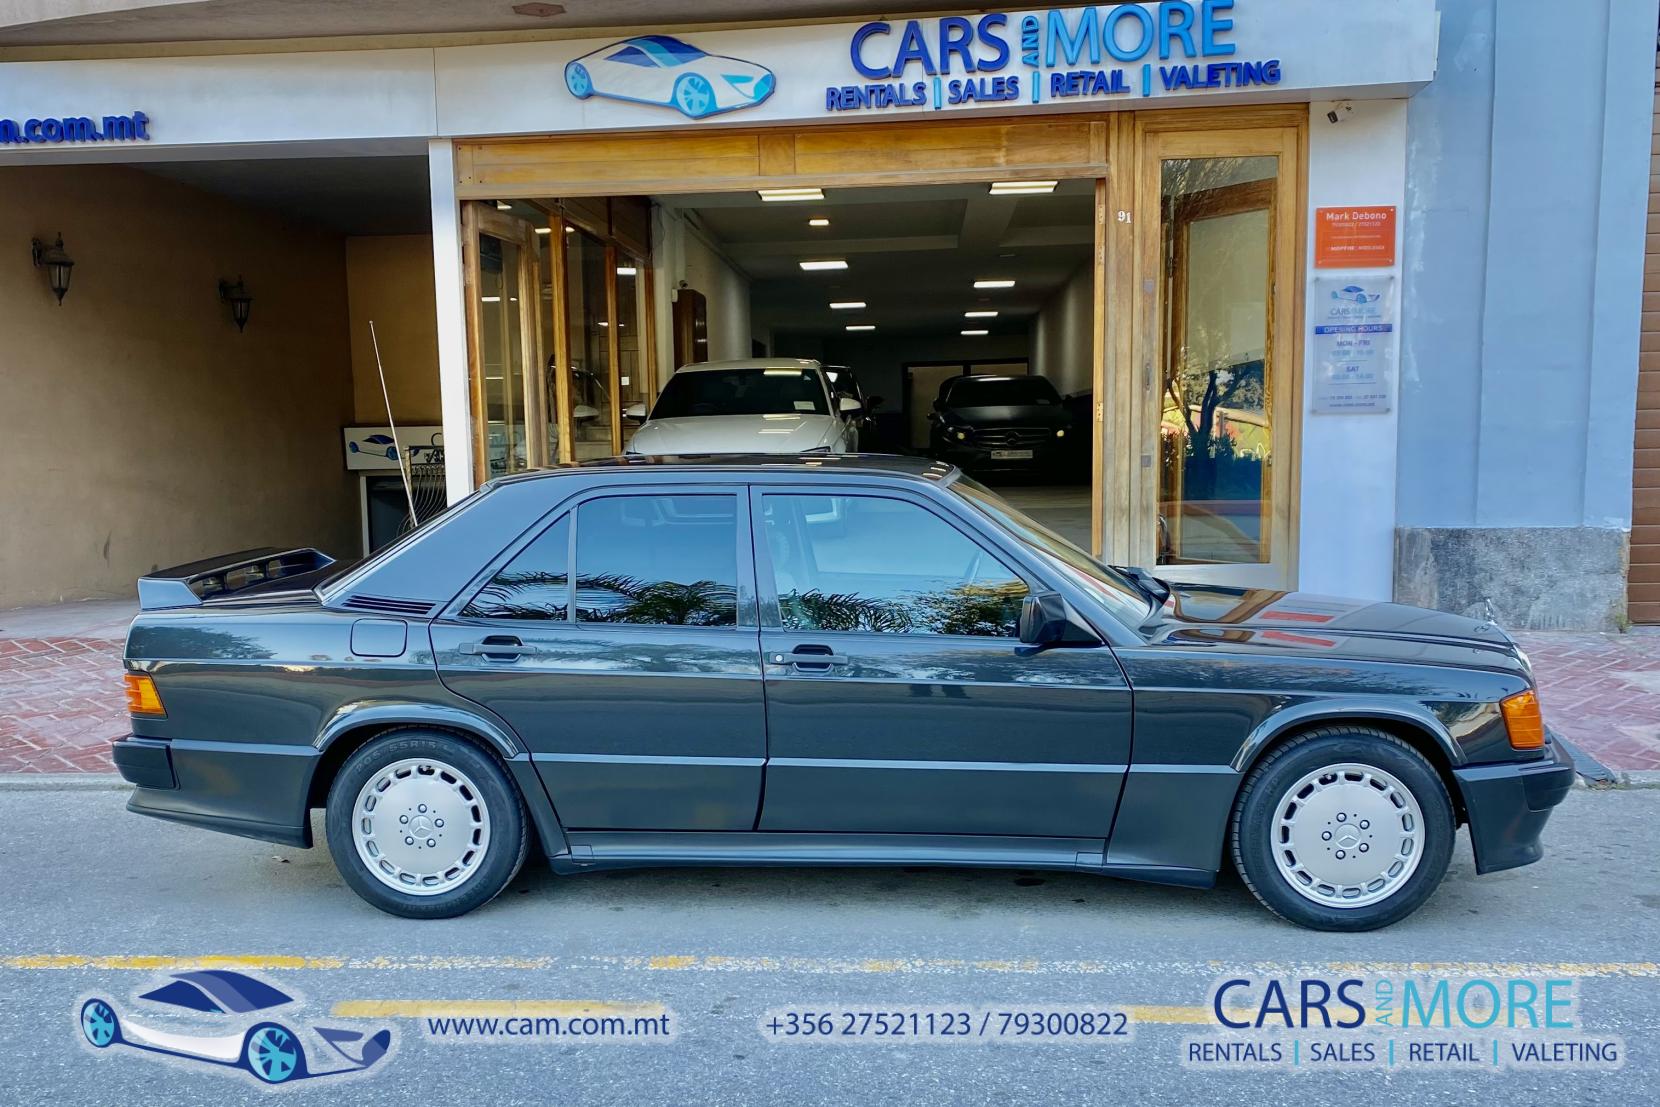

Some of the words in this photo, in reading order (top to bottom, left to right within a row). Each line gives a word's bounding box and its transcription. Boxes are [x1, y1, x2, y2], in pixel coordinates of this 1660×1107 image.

[851, 13, 1010, 80] CARS
[1021, 15, 1039, 68] AND
[1046, 0, 1236, 68] MORE
[826, 82, 927, 111] RENTALS
[948, 76, 1019, 104] SALES
[1050, 70, 1130, 97] RETAIL
[1160, 60, 1281, 90] VALETING
[1117, 210, 1131, 224] 91
[1326, 212, 1349, 221] Mark
[1352, 211, 1387, 220] Debono
[1323, 326, 1355, 334] OPENING
[1358, 325, 1383, 333] HOURS
